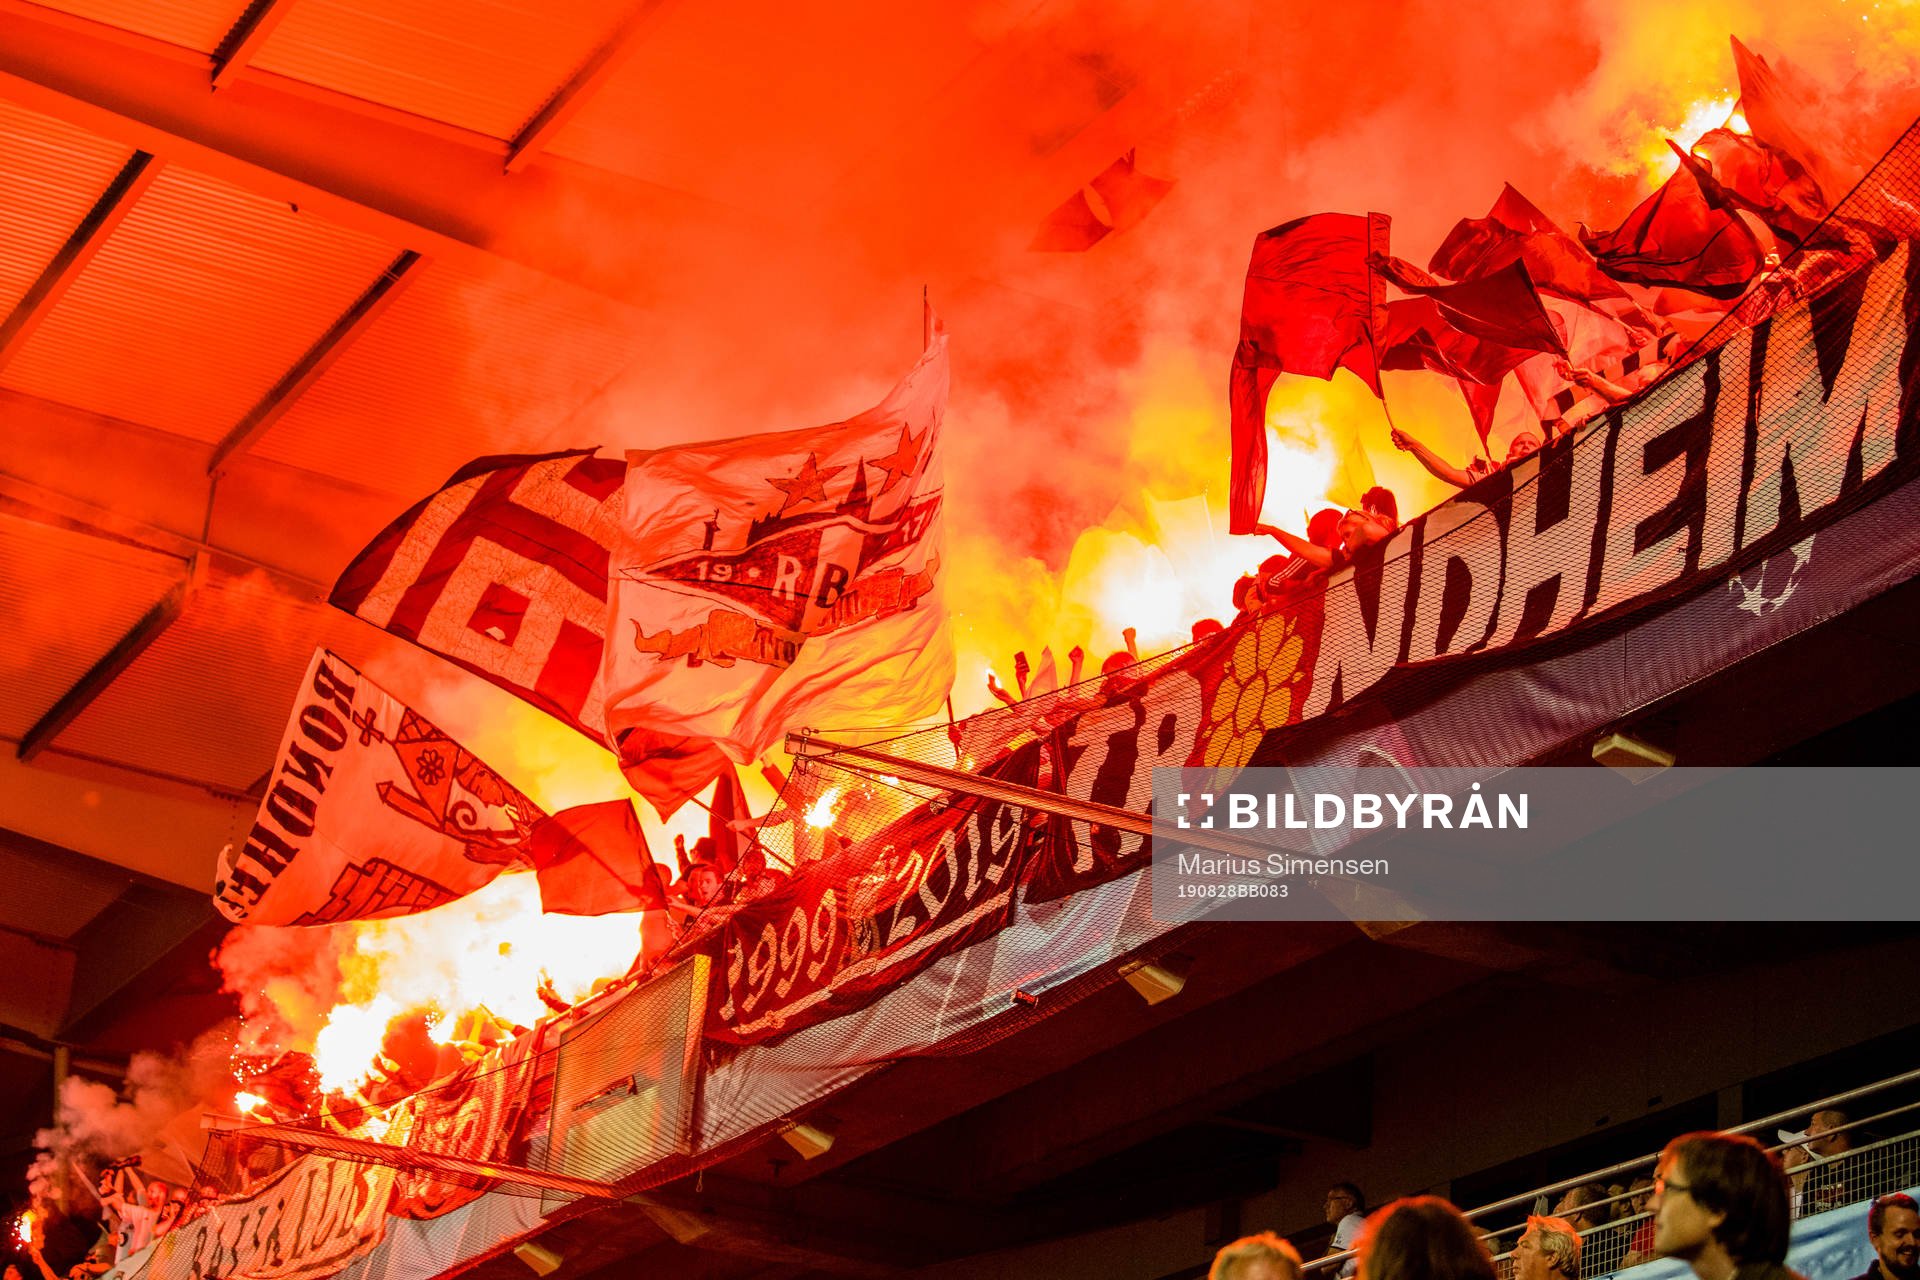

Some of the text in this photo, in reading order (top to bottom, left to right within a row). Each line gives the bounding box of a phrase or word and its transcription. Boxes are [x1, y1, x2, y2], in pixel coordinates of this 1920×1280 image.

[696, 561, 732, 582] 19
[719, 802, 1023, 1021] 1999 2019
